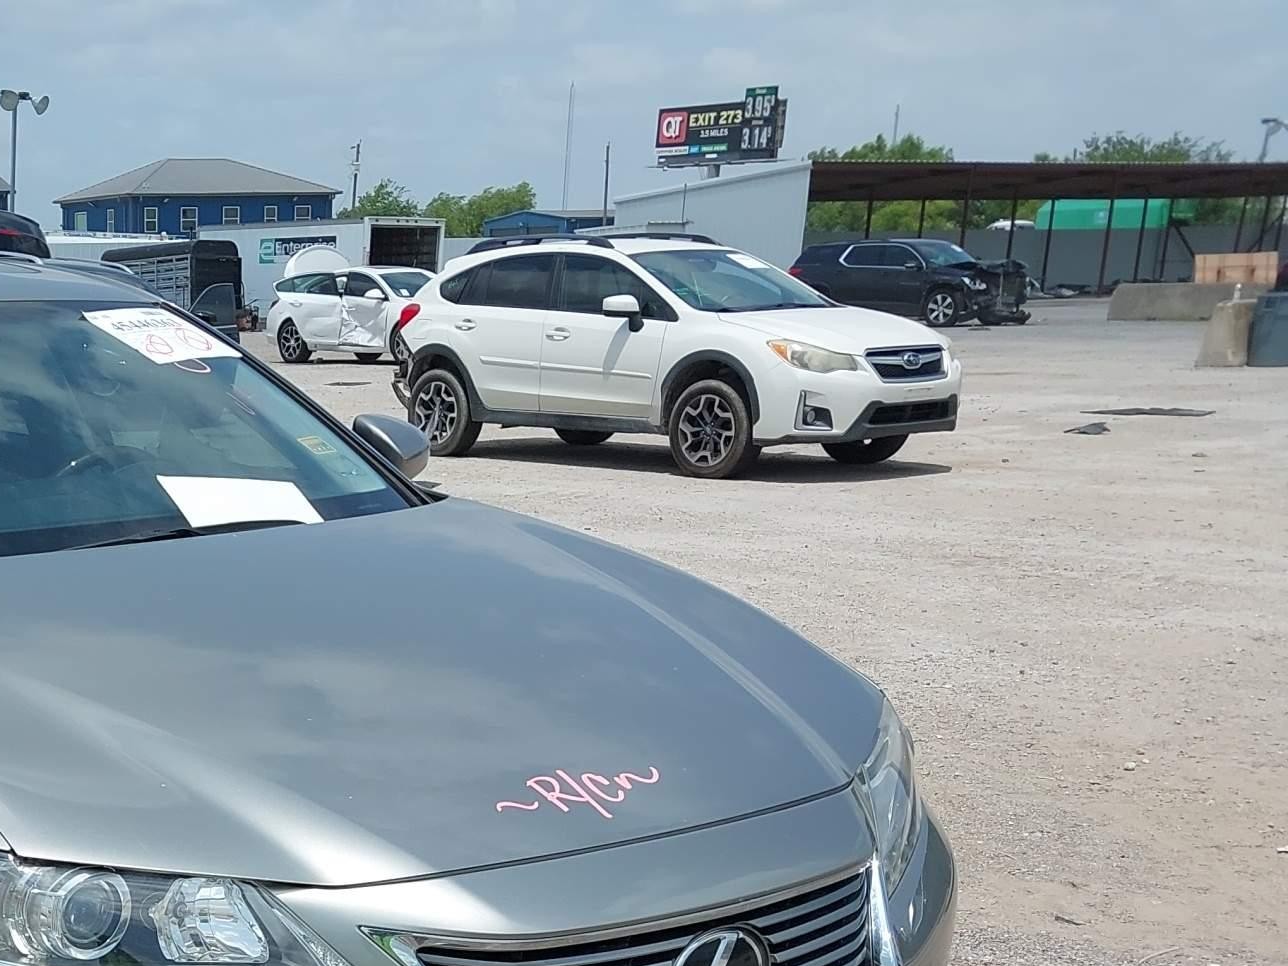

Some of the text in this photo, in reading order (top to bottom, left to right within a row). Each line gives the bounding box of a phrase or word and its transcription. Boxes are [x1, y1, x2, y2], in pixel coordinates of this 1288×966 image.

[663, 117, 682, 138] QT
[689, 112, 718, 127] EXIT
[719, 110, 742, 124] 273
